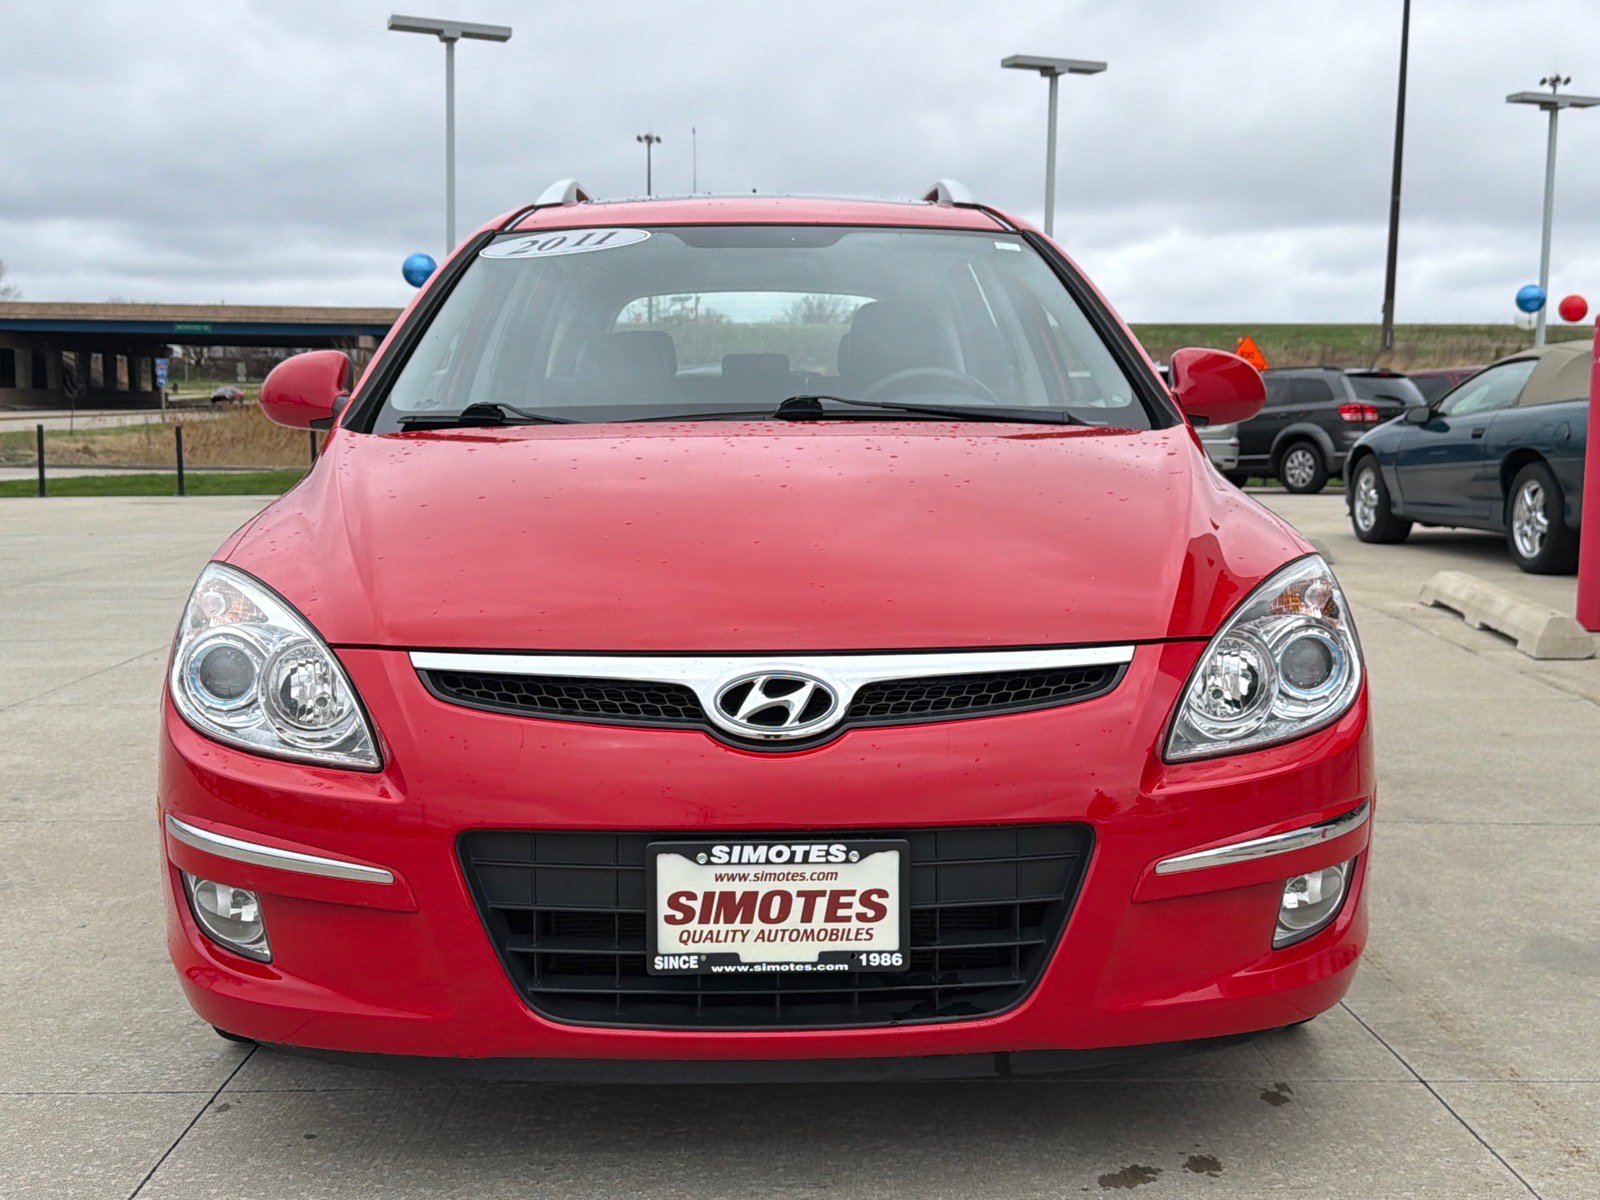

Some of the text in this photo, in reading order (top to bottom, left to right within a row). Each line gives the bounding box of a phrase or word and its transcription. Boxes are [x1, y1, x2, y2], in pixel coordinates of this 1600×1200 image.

[508, 231, 619, 255] 2011
[710, 845, 848, 864] SIMOTES
[714, 871, 839, 882] www.simotes.com
[663, 888, 890, 925] SIMOTES
[678, 928, 874, 945] QUALITY AUTOMOBILES
[654, 953, 903, 970] SINCE 1986
[711, 963, 849, 973] www.simotes.com
